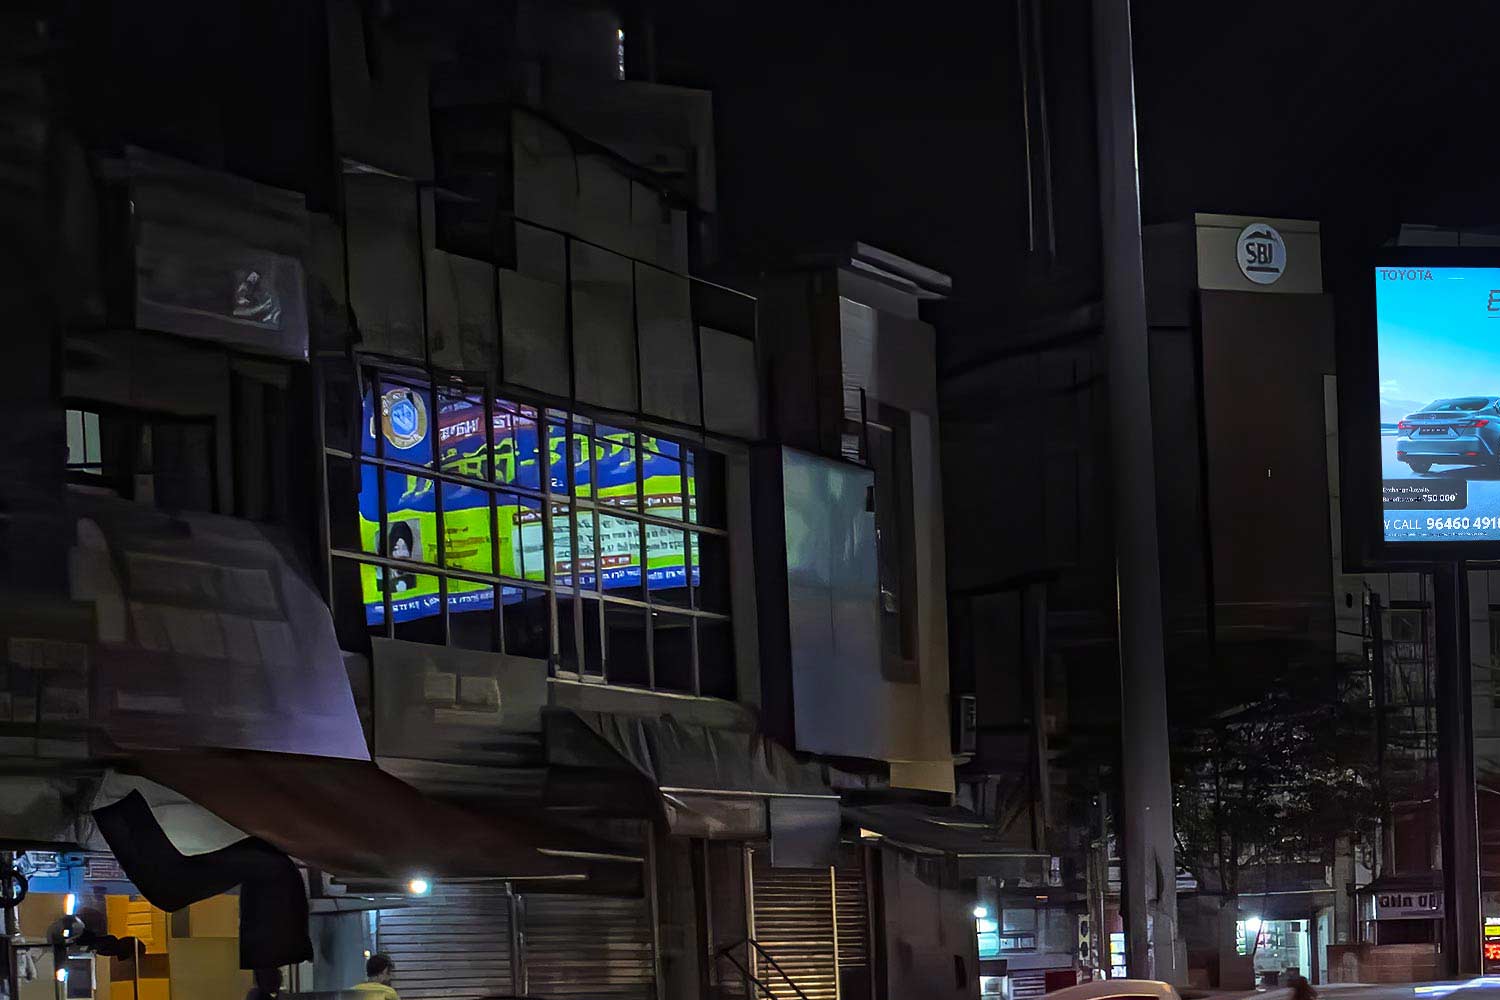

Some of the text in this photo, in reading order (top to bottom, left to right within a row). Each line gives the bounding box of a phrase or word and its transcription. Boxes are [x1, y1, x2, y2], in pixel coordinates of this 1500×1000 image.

[1245, 242, 1273, 264] SBI
[1379, 269, 1434, 281] TOYOTA
[1394, 519, 1422, 530] CALL
[1426, 517, 1470, 530] 96460
